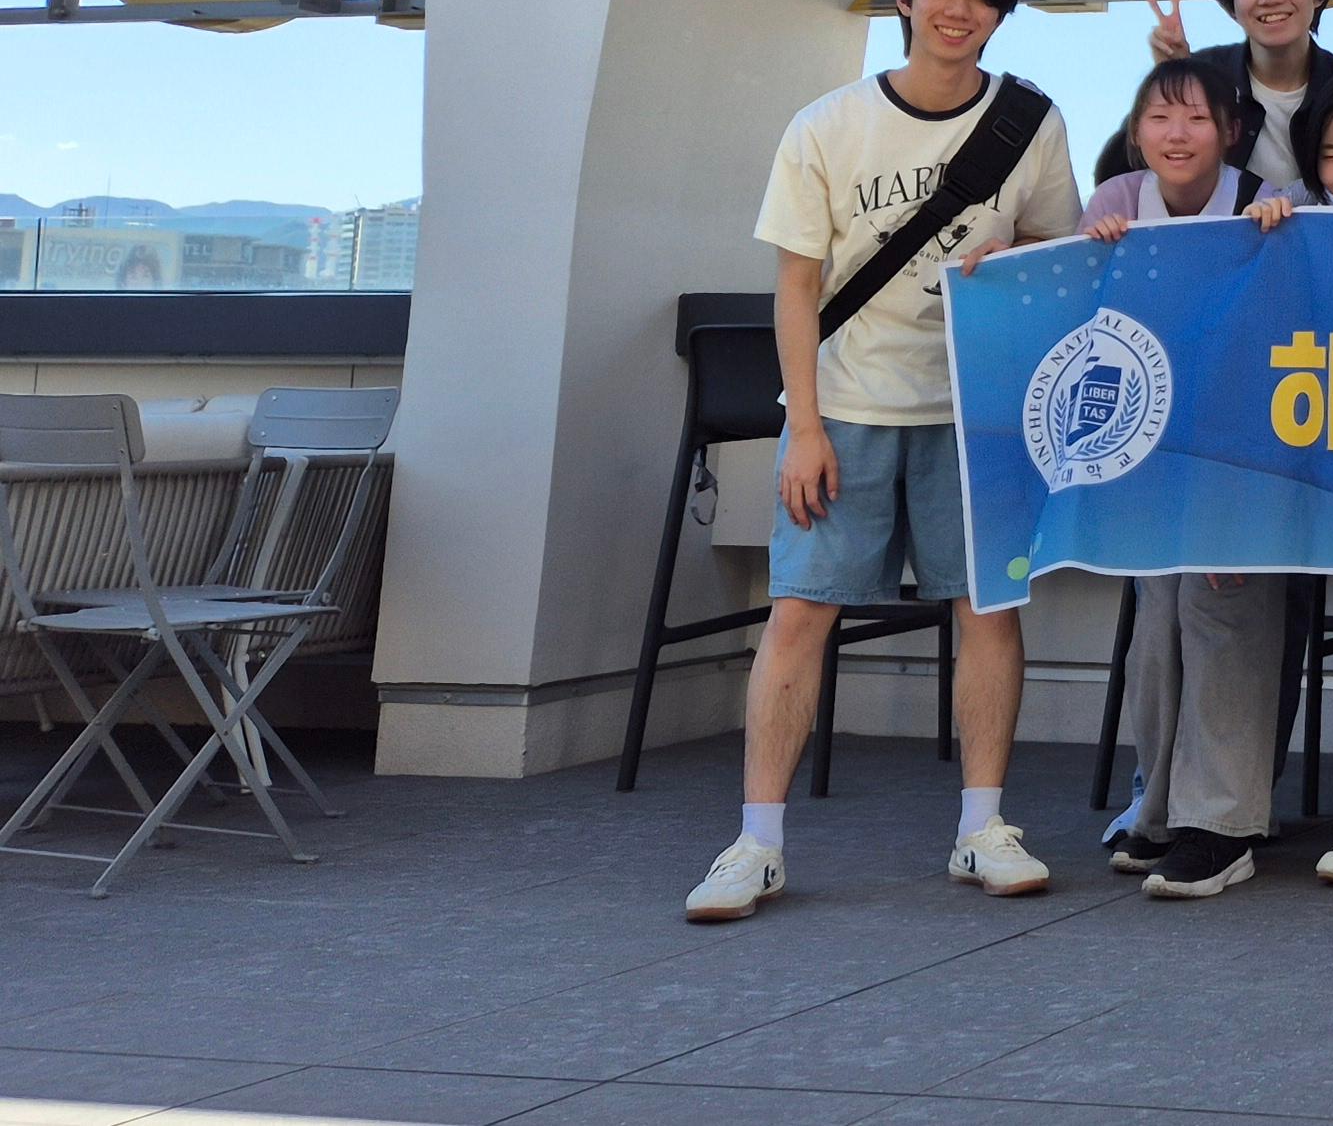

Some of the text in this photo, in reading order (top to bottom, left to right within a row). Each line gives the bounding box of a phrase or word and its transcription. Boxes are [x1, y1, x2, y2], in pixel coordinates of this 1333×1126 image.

[1029, 315, 1167, 466] INCHEON NATIAL UNIVERSITY
[1083, 387, 1116, 401] LIBER
[1083, 406, 1107, 420] TAS
